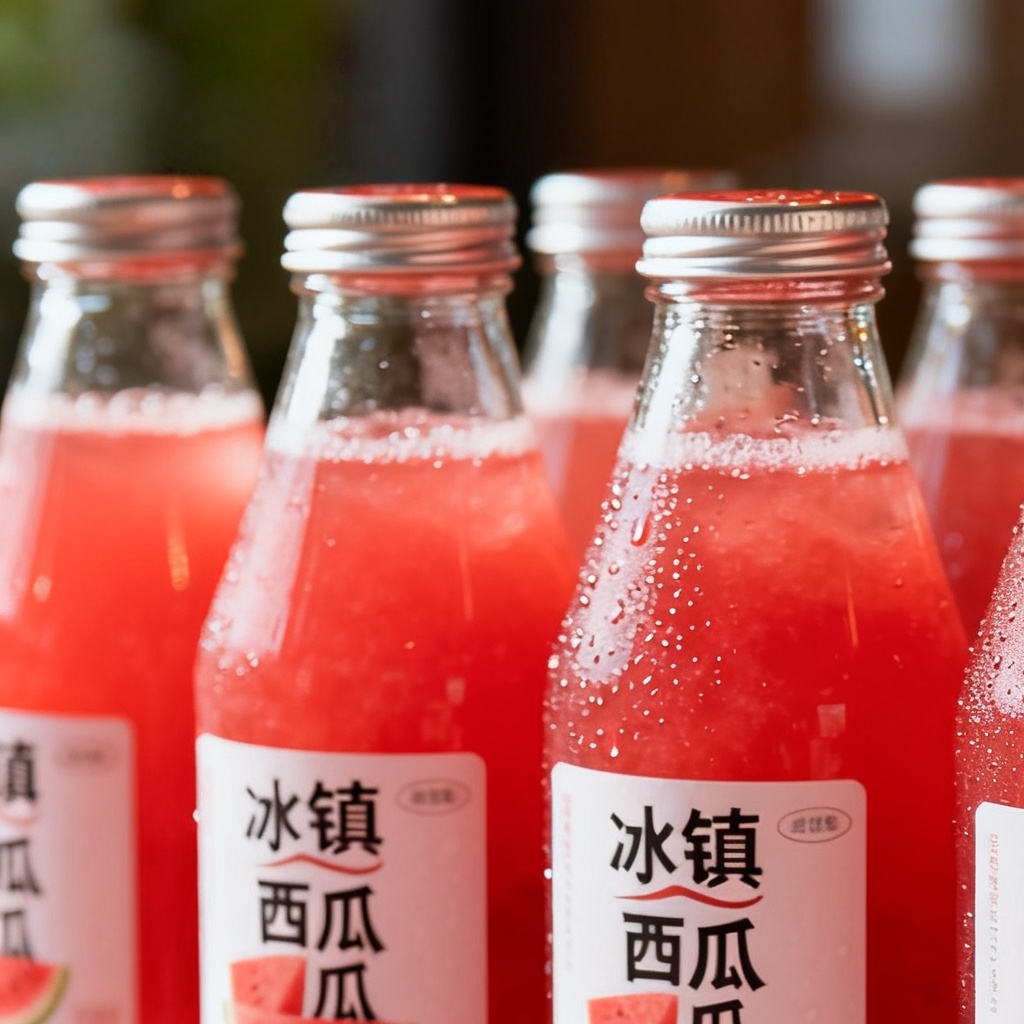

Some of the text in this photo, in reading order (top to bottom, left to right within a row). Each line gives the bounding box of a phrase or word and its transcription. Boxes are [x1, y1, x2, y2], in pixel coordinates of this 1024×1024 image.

[247, 780, 383, 855] 冰镇
[610, 805, 763, 889] 冰镇
[258, 880, 385, 953] 西瓜
[623, 912, 766, 992] 西瓜
[314, 963, 378, 1022] 瓜
